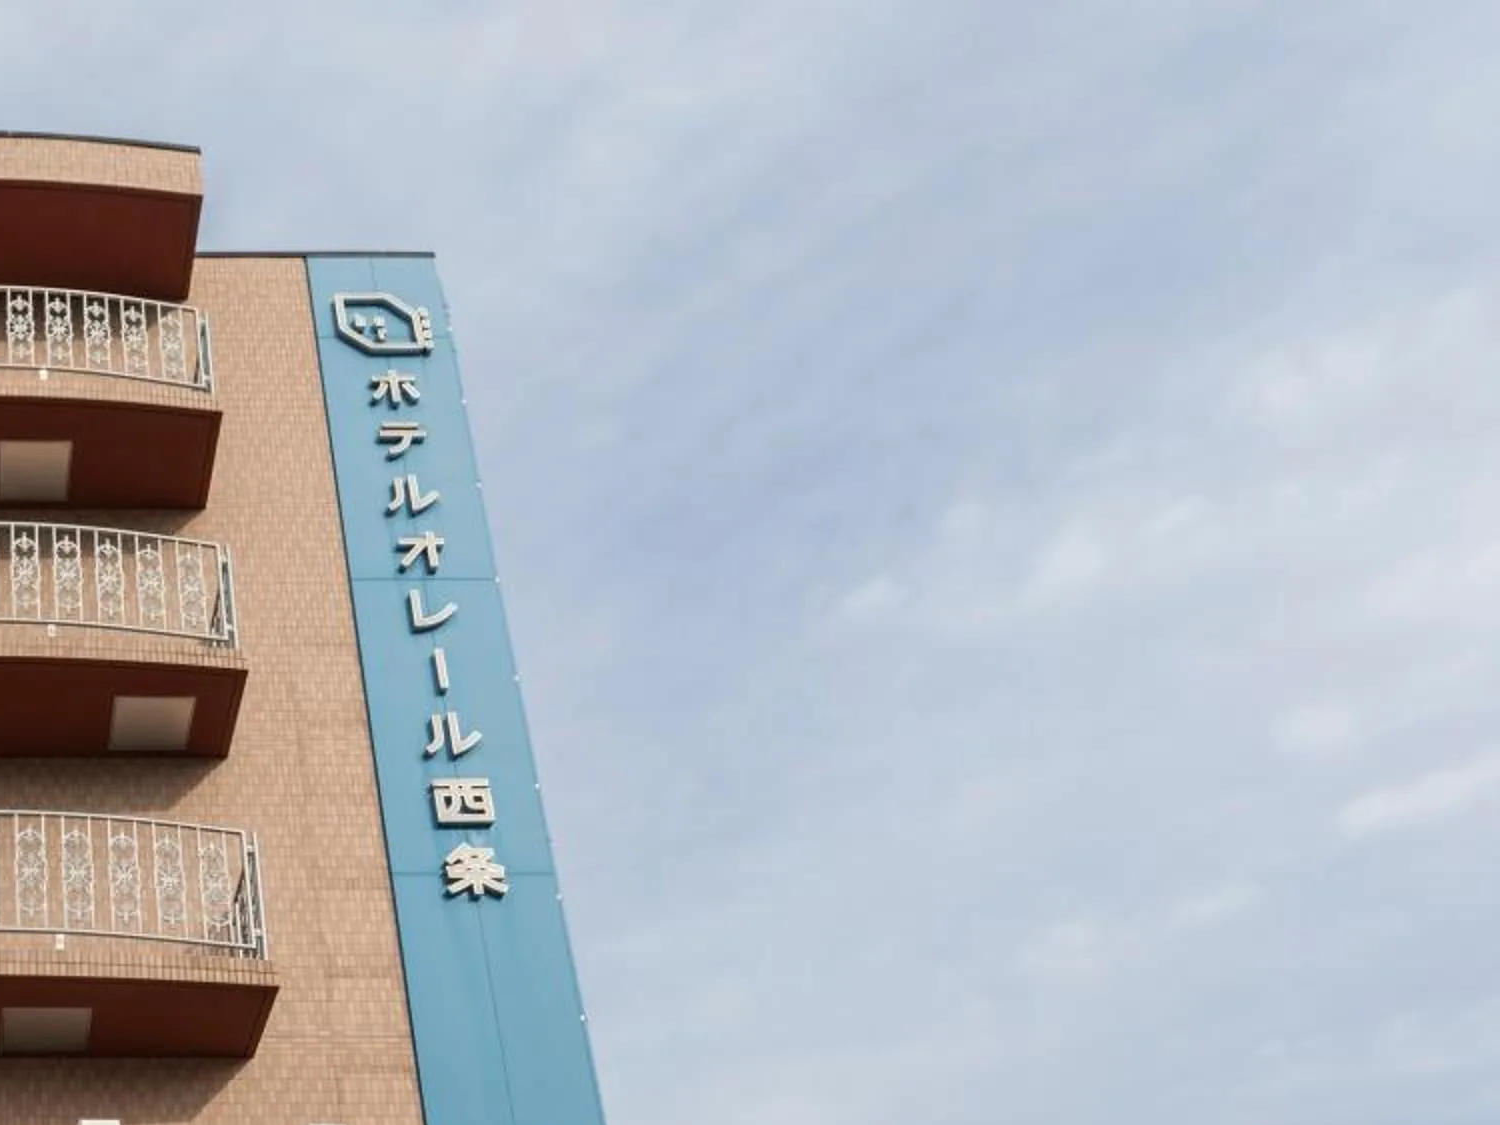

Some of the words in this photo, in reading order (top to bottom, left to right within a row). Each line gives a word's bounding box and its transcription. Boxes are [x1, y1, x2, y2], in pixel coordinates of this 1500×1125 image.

[369, 369, 508, 900] ホテルオレール西条
